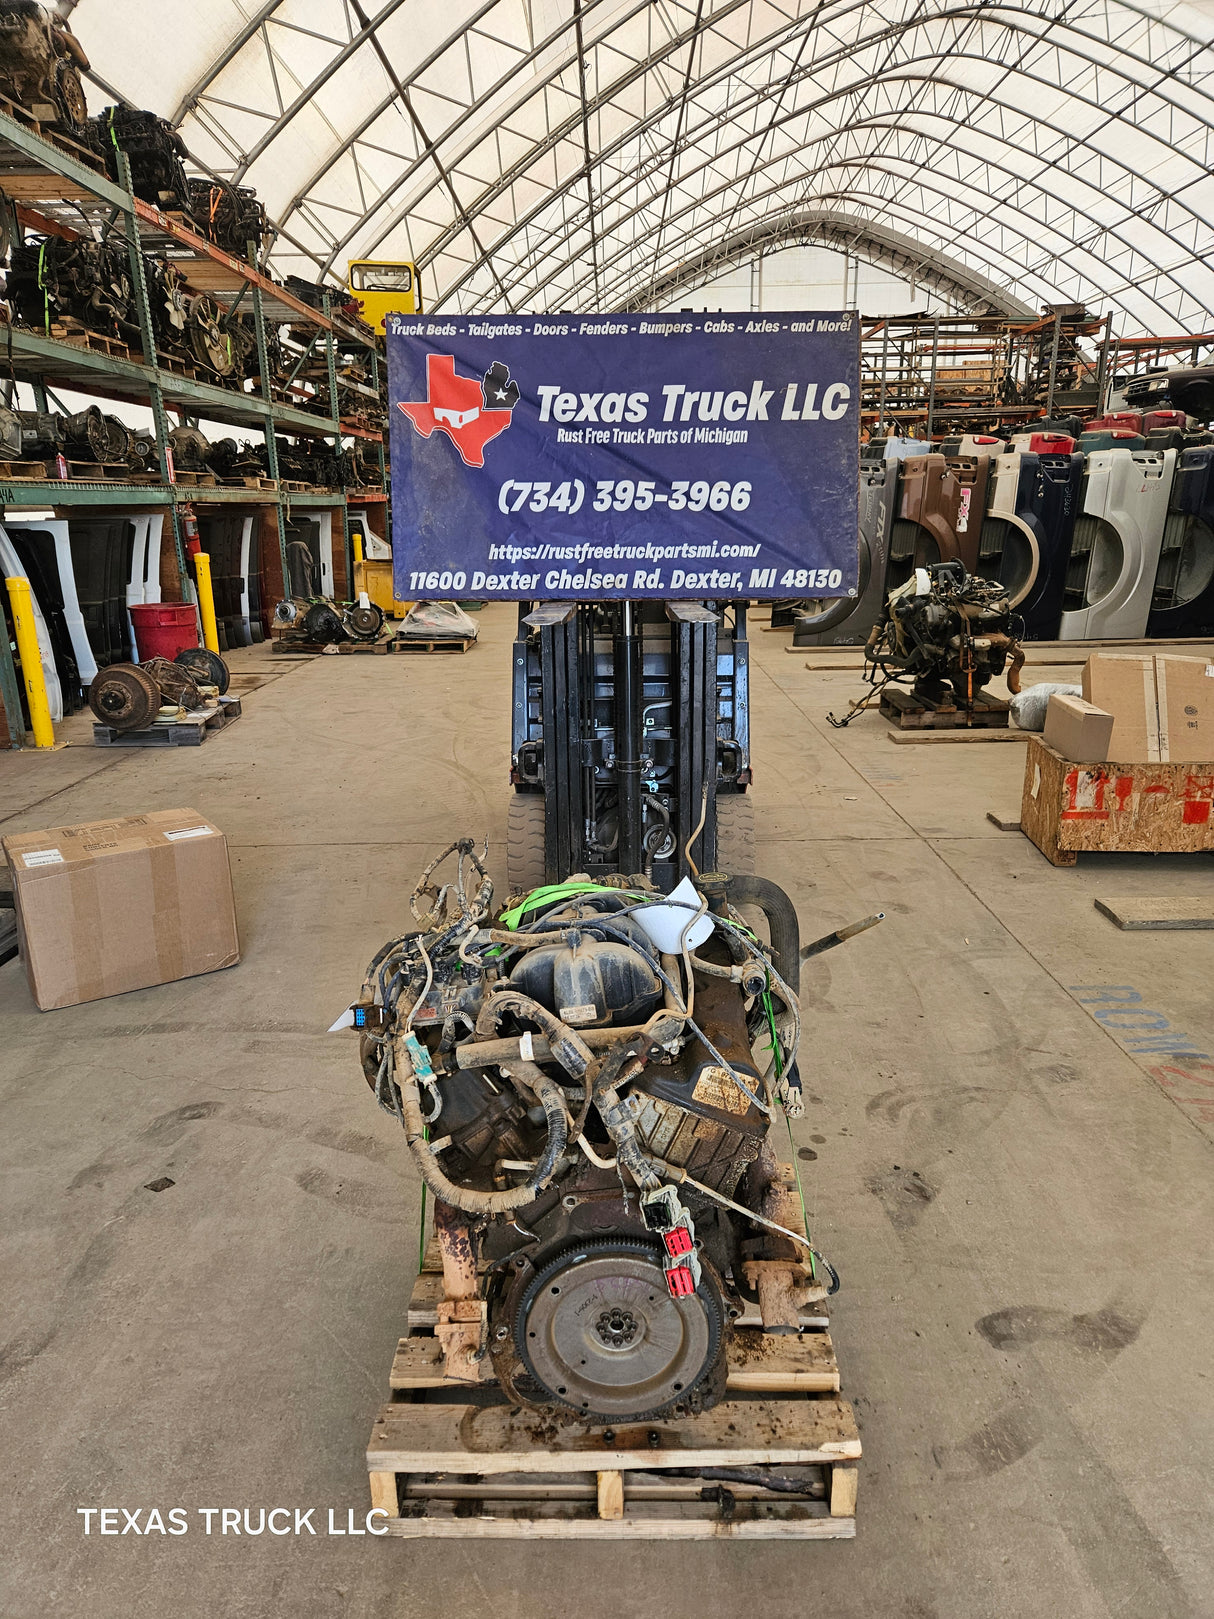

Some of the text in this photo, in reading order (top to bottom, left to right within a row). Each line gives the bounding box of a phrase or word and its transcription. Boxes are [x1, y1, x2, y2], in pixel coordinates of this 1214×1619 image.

[391, 323, 424, 336] Truck
[426, 323, 457, 336] Beds
[468, 322, 522, 339] Tailgates
[533, 323, 569, 336] Doors
[579, 321, 628, 335] Fenders
[639, 321, 693, 337] Bumpers
[703, 321, 735, 333] Cabs
[745, 320, 780, 333] Axles
[791, 320, 814, 332] and
[817, 319, 853, 332] More!
[537, 380, 851, 423] Texas Truck LLC
[557, 427, 748, 446] Rust Free Truck Parts of Michigan
[498, 478, 753, 515] (734) 395-3966
[488, 540, 762, 564] https://rustfreetruckpartsmi.com/
[409, 568, 842, 592] 11600 Dexter Chelsea Rd. Dexter, MI 48130
